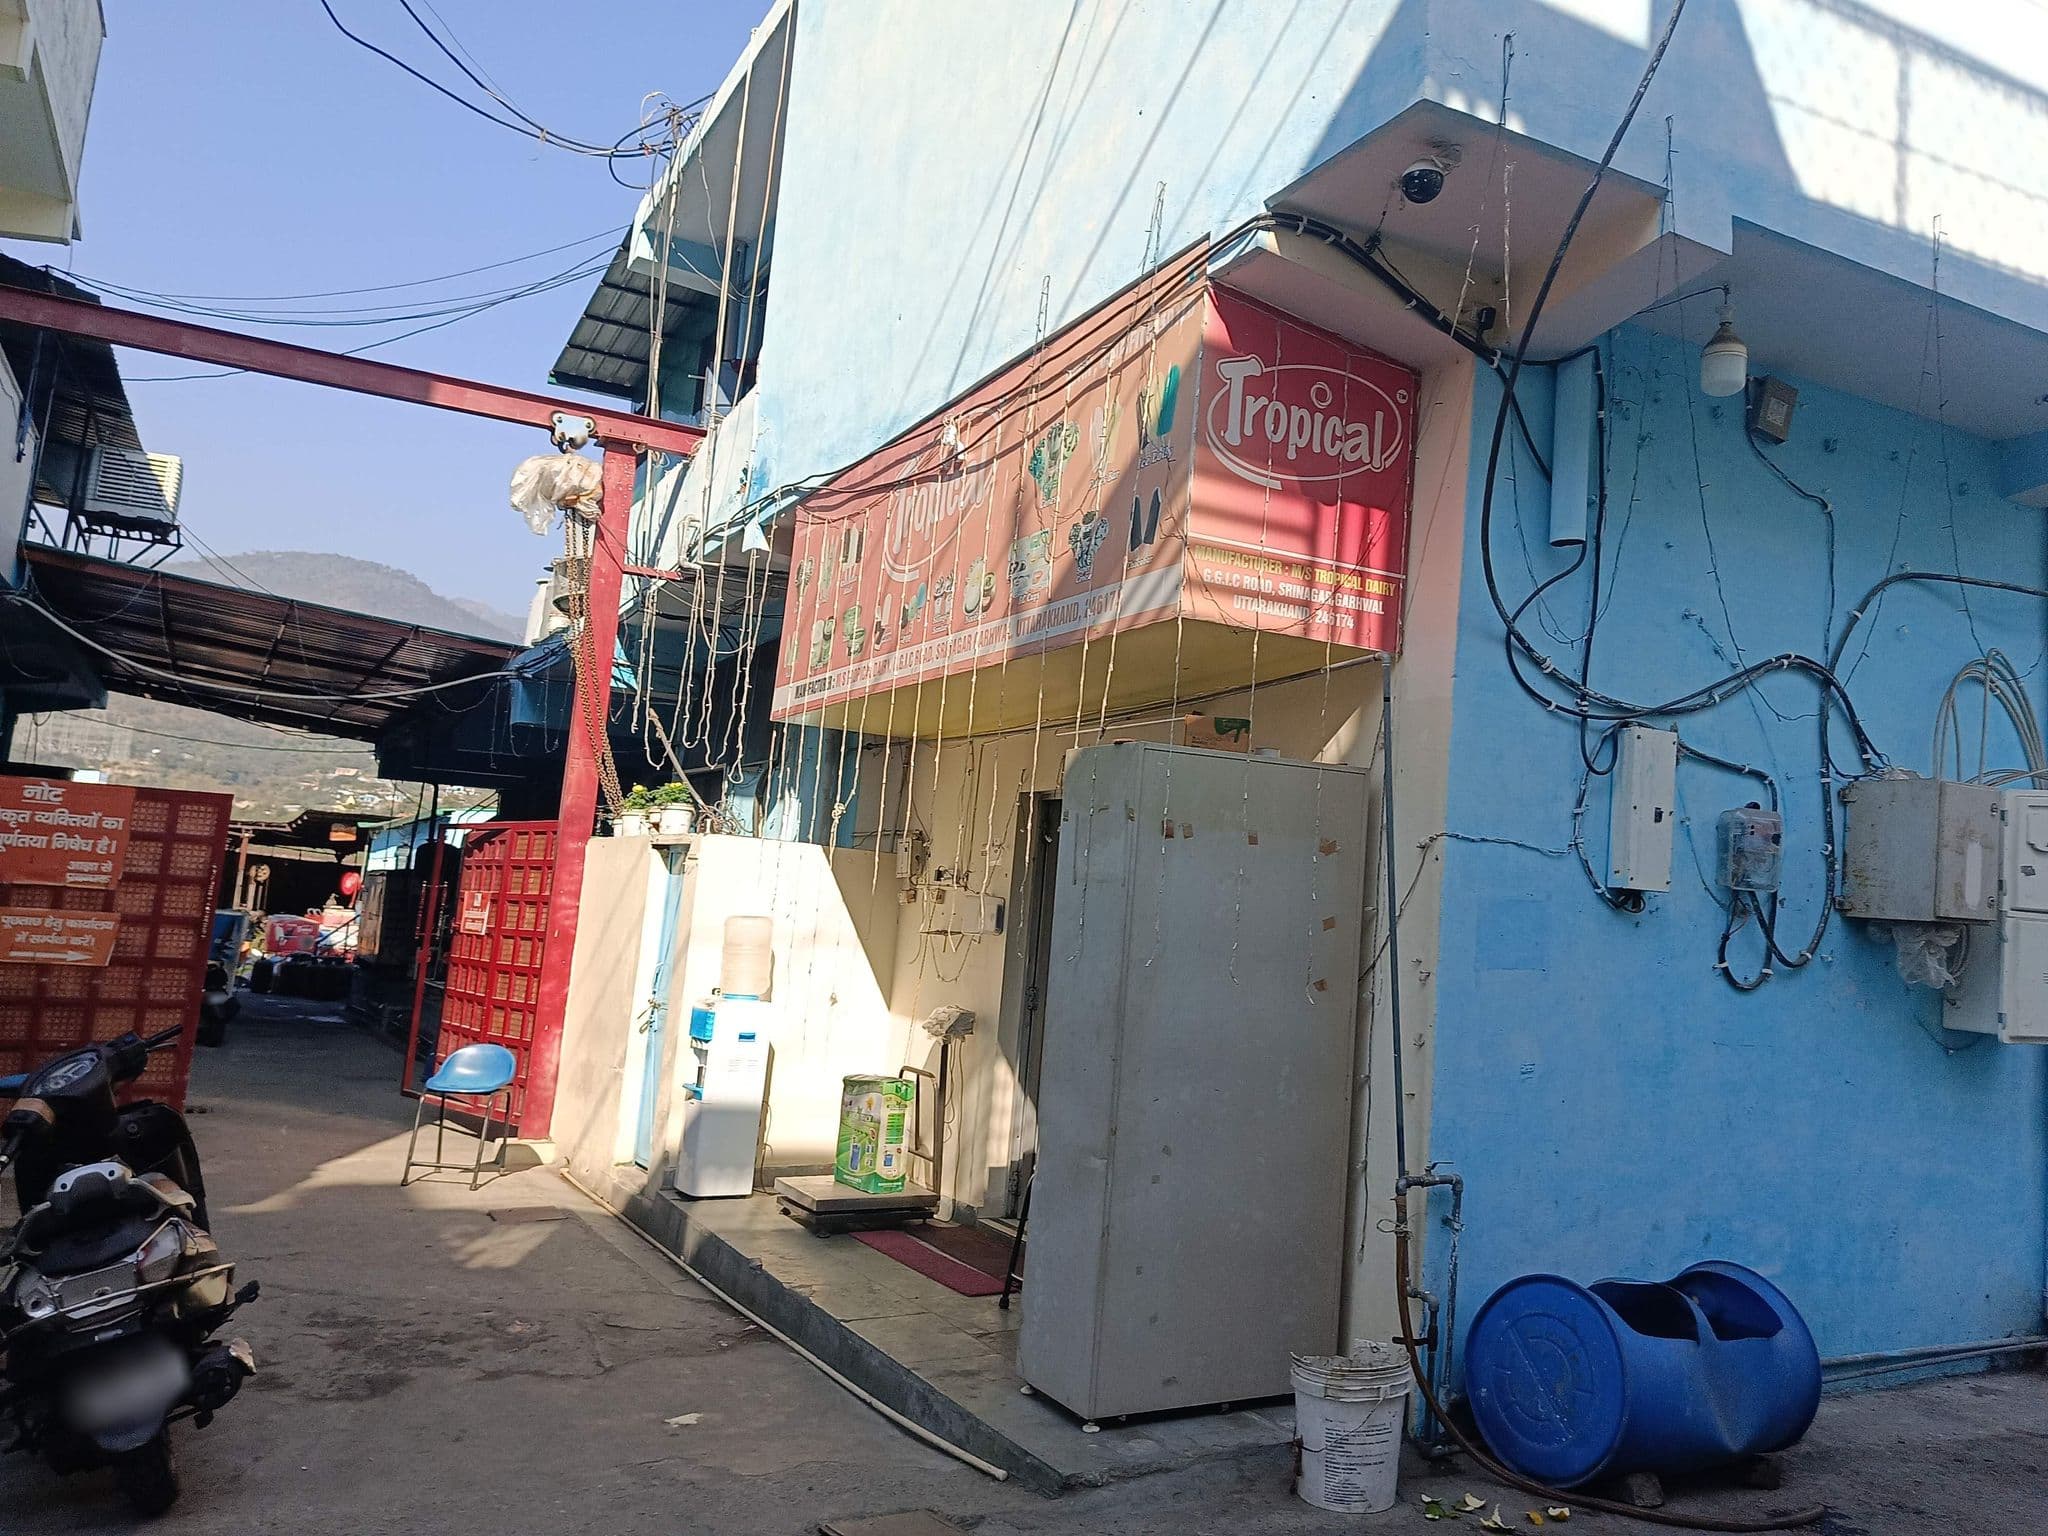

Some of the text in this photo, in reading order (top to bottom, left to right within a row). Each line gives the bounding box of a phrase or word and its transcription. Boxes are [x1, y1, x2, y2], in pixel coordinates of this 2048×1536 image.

[1217, 356, 1386, 470] Tropical
[1194, 545, 1283, 576] MANUFACTURER
[1291, 562, 1312, 581] M/S
[1315, 569, 1364, 591] TROPICAL
[1365, 579, 1397, 597] DAIRY
[1315, 609, 1355, 629] 246174
[22, 781, 67, 802] नोट
[0, 808, 126, 830] कृत व्यक्तियों का
[51, 832, 94, 852] निषेध
